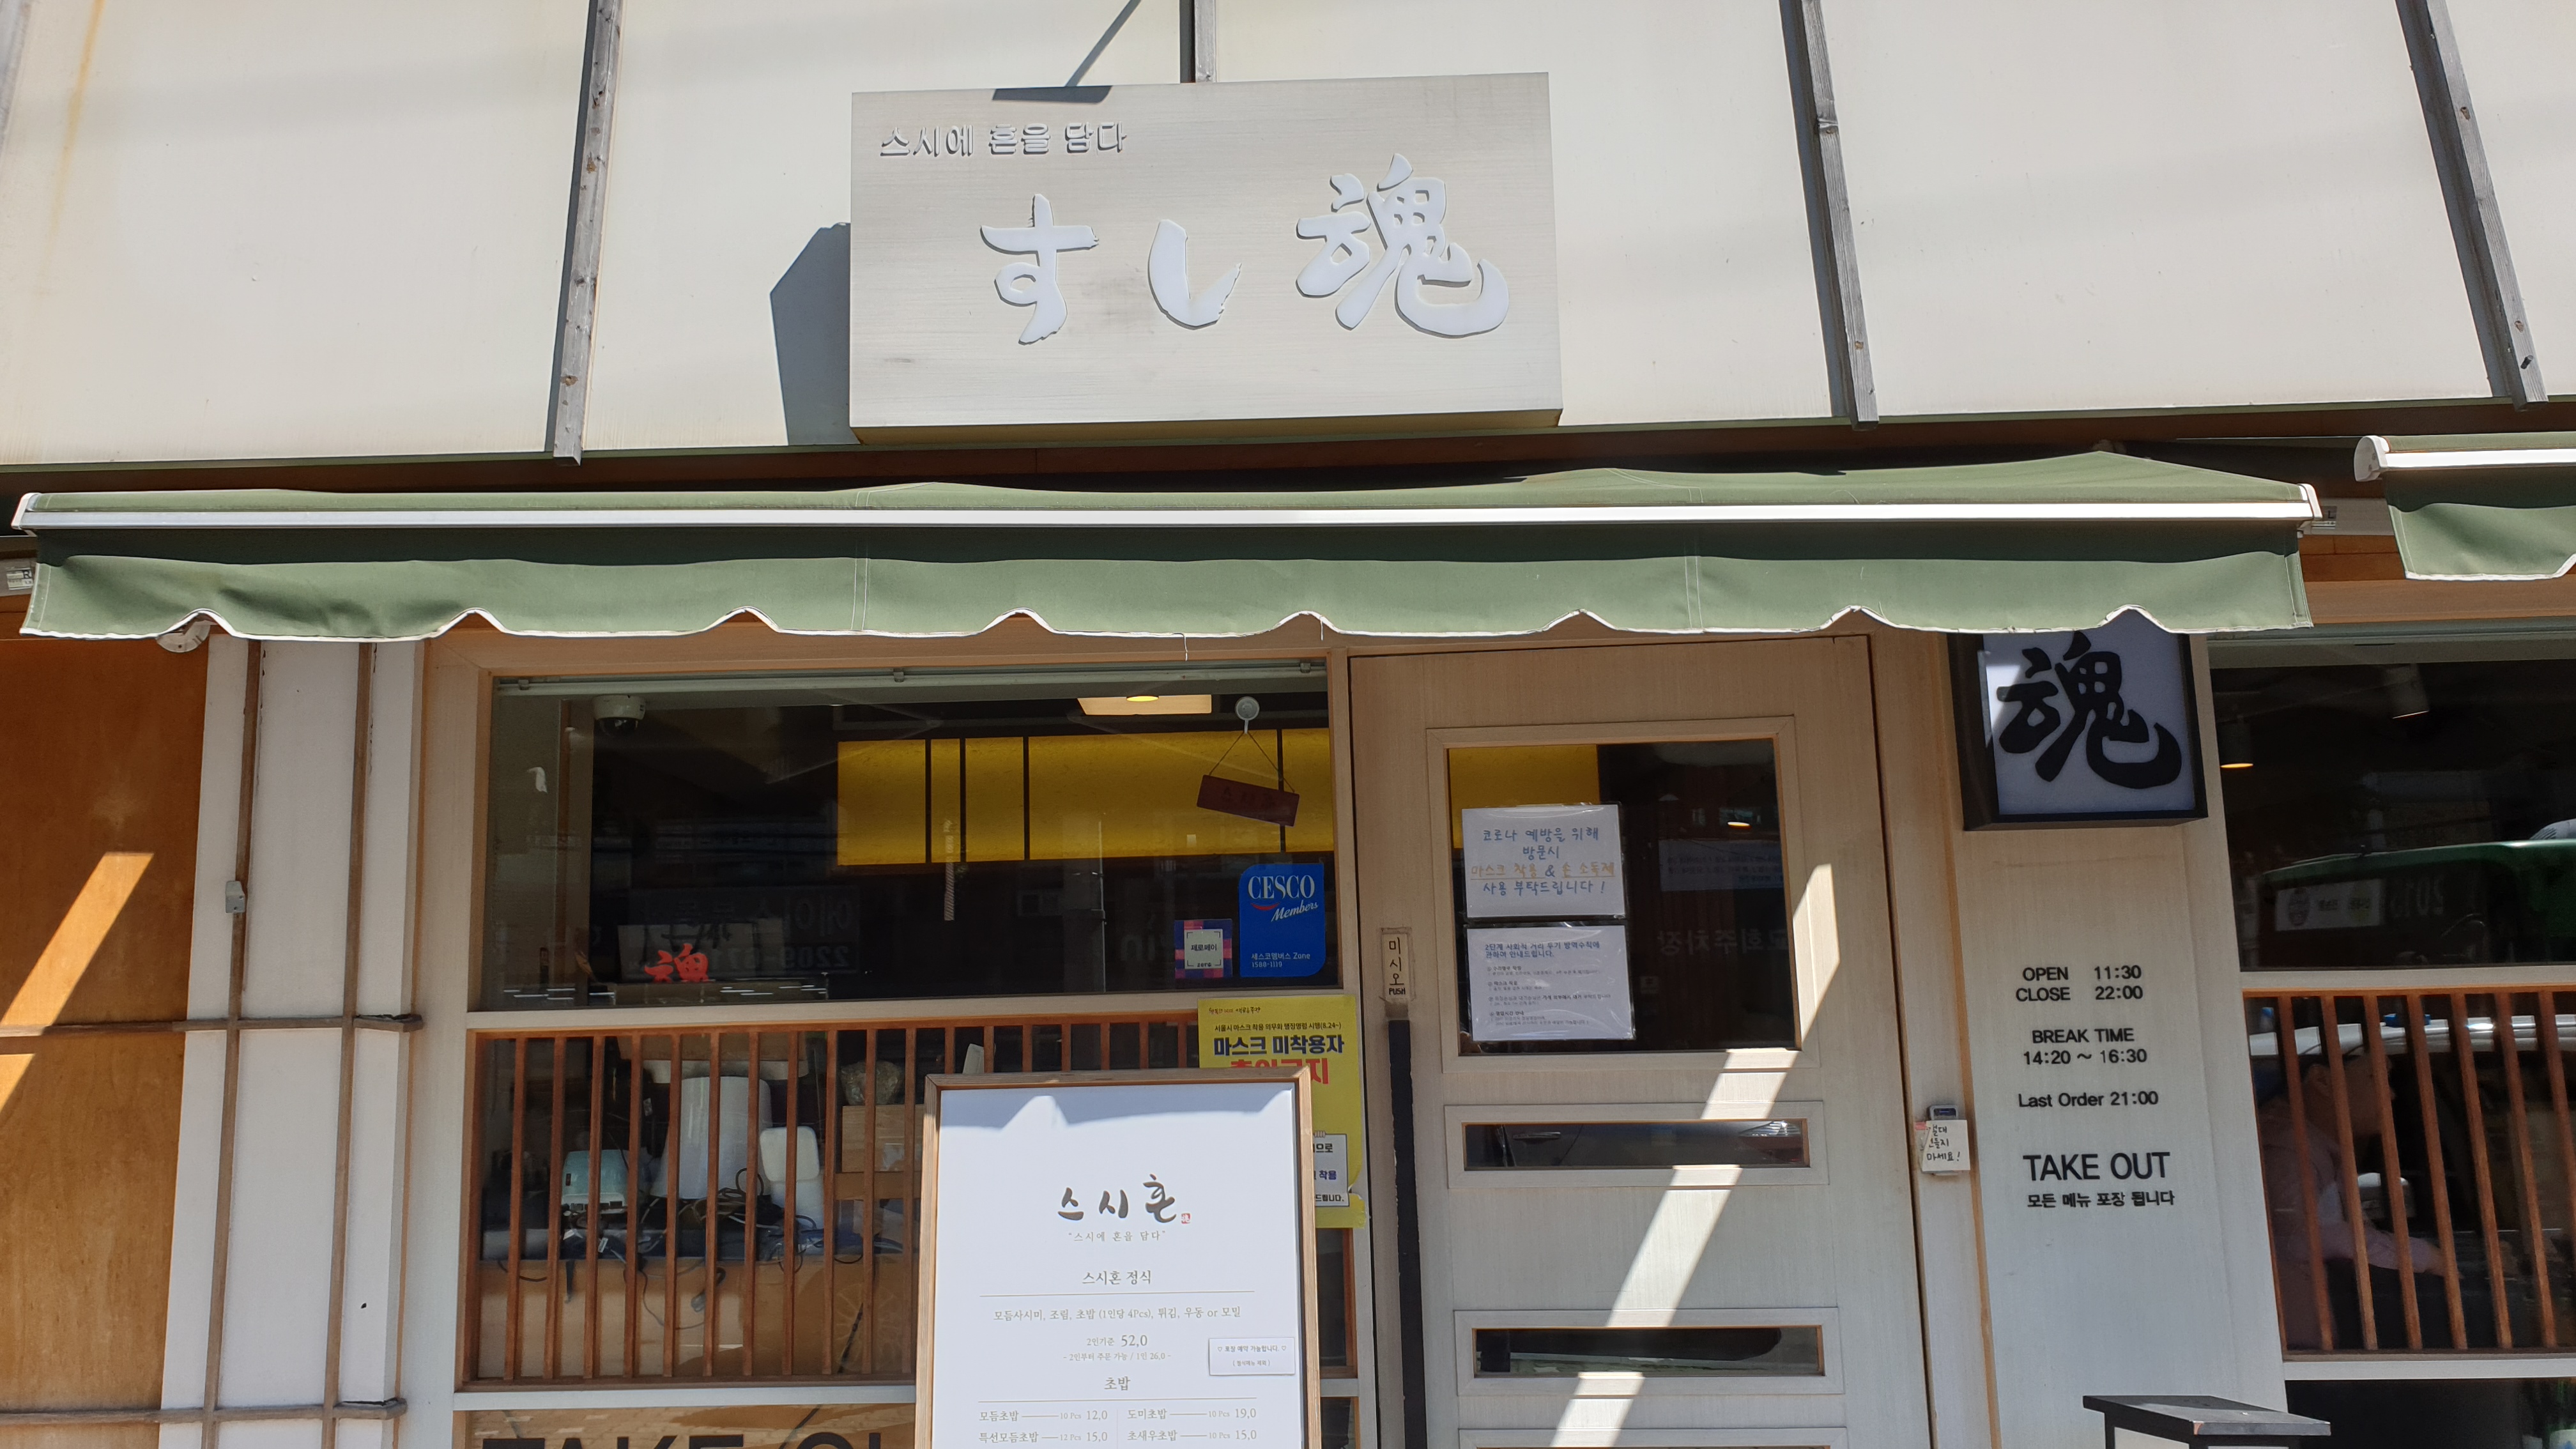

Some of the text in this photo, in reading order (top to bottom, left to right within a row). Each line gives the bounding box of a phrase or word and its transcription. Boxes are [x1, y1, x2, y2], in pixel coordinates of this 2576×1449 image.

[880, 121, 1127, 157] 스시에 혼을 담다
[1997, 631, 2182, 789] 魂
[1483, 827, 1599, 842] 코로나 예방을 위해
[1523, 845, 1560, 860] 방문시
[1471, 864, 1506, 877] 마스크
[1545, 864, 1555, 878] &
[1248, 875, 1315, 900] CESCO
[1483, 882, 1506, 896] 사용
[1514, 881, 1593, 896] 부탁드립니다
[1271, 899, 1319, 922] Members
[1191, 943, 1217, 952] 제로페이
[1293, 952, 1311, 960] Zone
[1388, 937, 1405, 985] 미시오
[2022, 965, 2142, 981] OPEN 11:30
[2016, 985, 2143, 1002] CLOSE 22:00
[2032, 1028, 2135, 1043] BREAK TIME
[1213, 1034, 1345, 1057] 마스크 미착용자
[2023, 1050, 2071, 1065] 14:20
[2100, 1048, 2147, 1063] 16:30
[2018, 1091, 2159, 1108] Last Order 21:00
[1313, 1143, 1333, 1153] 으로
[1926, 1151, 1954, 1162] 마세요
[2023, 1151, 2171, 1181] TAKE OUT
[1319, 1170, 1337, 1180] 착용
[1057, 1174, 1177, 1223] 스시혼
[2027, 1190, 2175, 1208] 모든 메뉴 포장 됩니다
[1112, 1231, 1133, 1242] 혼을
[1082, 1269, 1152, 1286] 스시혼 정식
[993, 1308, 1046, 1321] 모듬사시미,
[1049, 1308, 1071, 1321] 조림,
[1075, 1308, 1096, 1320] 초밥
[1099, 1307, 1125, 1320] (1인당
[1158, 1307, 1180, 1319] 튀김,
[1184, 1307, 1204, 1319] 우동
[1207, 1309, 1218, 1317] or
[1222, 1306, 1241, 1319] 모밀
[1087, 1335, 1148, 1347] 2인기준 52,0
[1097, 1352, 1112, 1361] 주문
[1114, 1352, 1128, 1360] 가능
[1104, 1376, 1131, 1391] 초밥
[979, 1410, 1019, 1422] 모듬초밥
[1086, 1410, 1108, 1422] 12,0
[1127, 1409, 1168, 1420] 도미초밥
[1235, 1408, 1257, 1419] 19,0
[978, 1431, 1039, 1444] 특선모듬초밥
[1086, 1431, 1108, 1443] 15,0
[1127, 1429, 1177, 1441] 초새우초밥
[1236, 1429, 1257, 1441] 15,0
